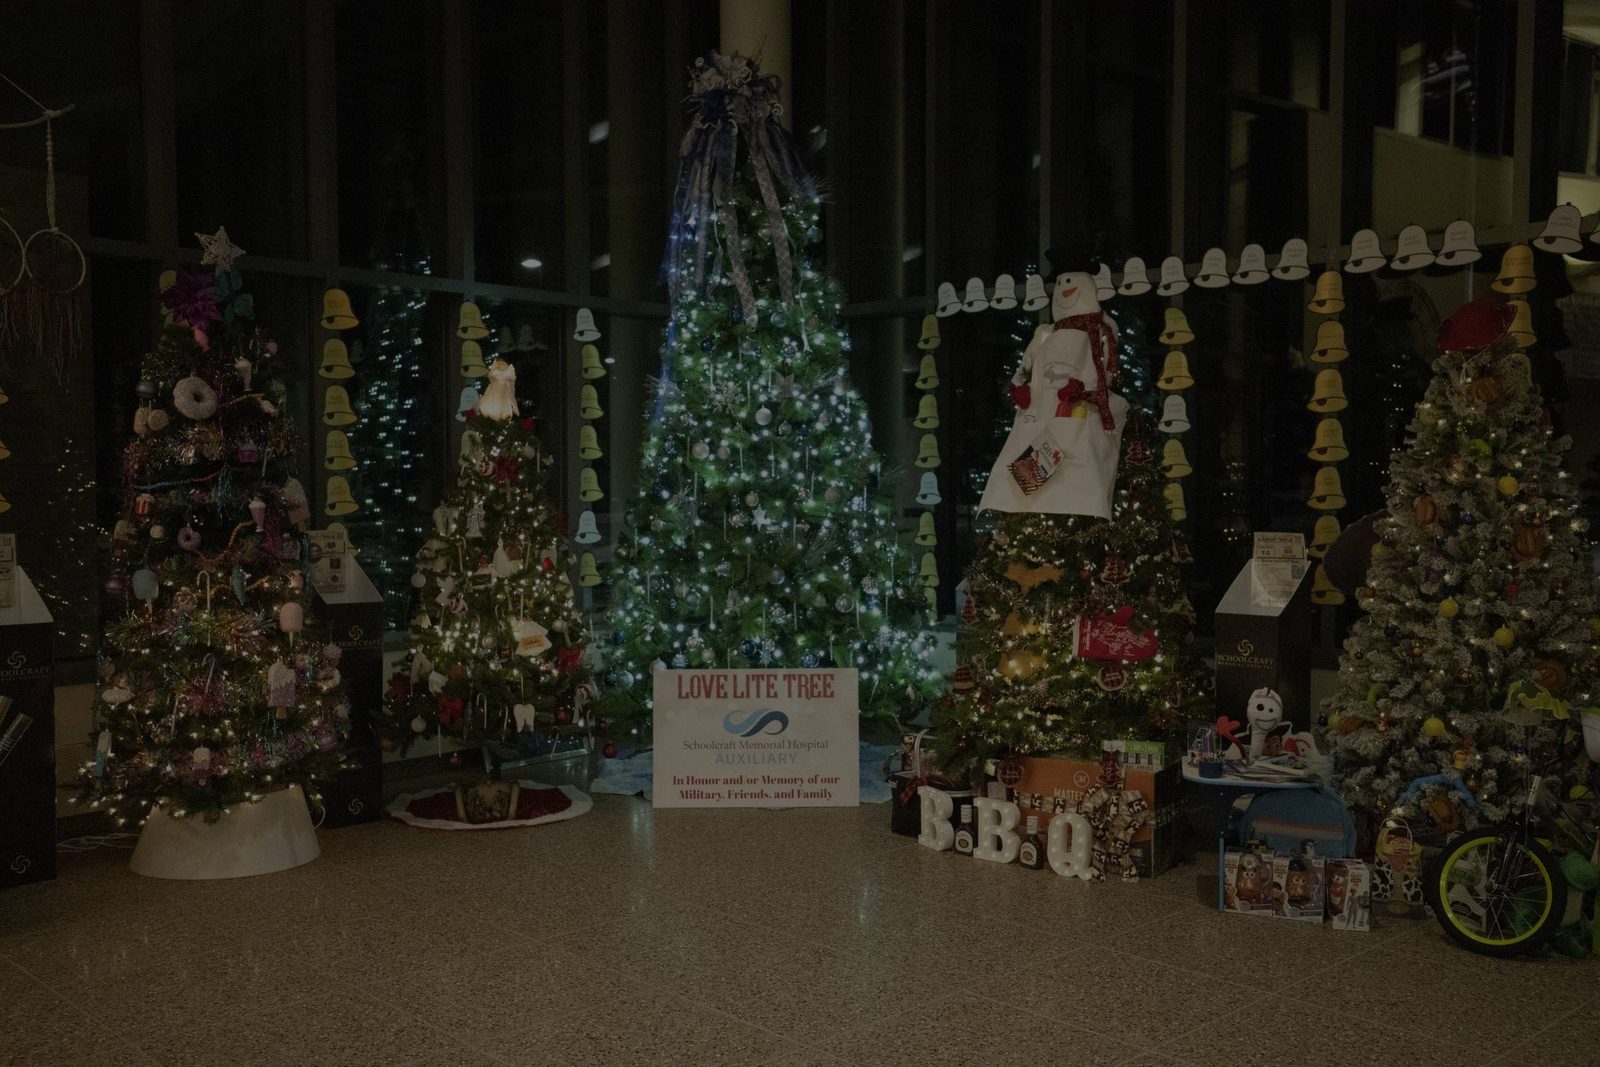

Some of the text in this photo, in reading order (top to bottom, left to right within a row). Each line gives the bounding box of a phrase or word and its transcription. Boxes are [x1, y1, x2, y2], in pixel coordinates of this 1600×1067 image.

[677, 673, 834, 700] LOVE LITE TREE
[683, 739, 829, 752] Schoolcraft Memorial Hospital
[714, 752, 798, 765] AUXILIARY
[672, 775, 684, 785] In
[686, 775, 720, 785] Honor
[762, 774, 805, 787] Memory
[808, 774, 820, 785] of
[820, 777, 840, 785] our
[774, 788, 794, 799] and
[797, 788, 833, 801] Family
[1053, 787, 1085, 802] MASTER
